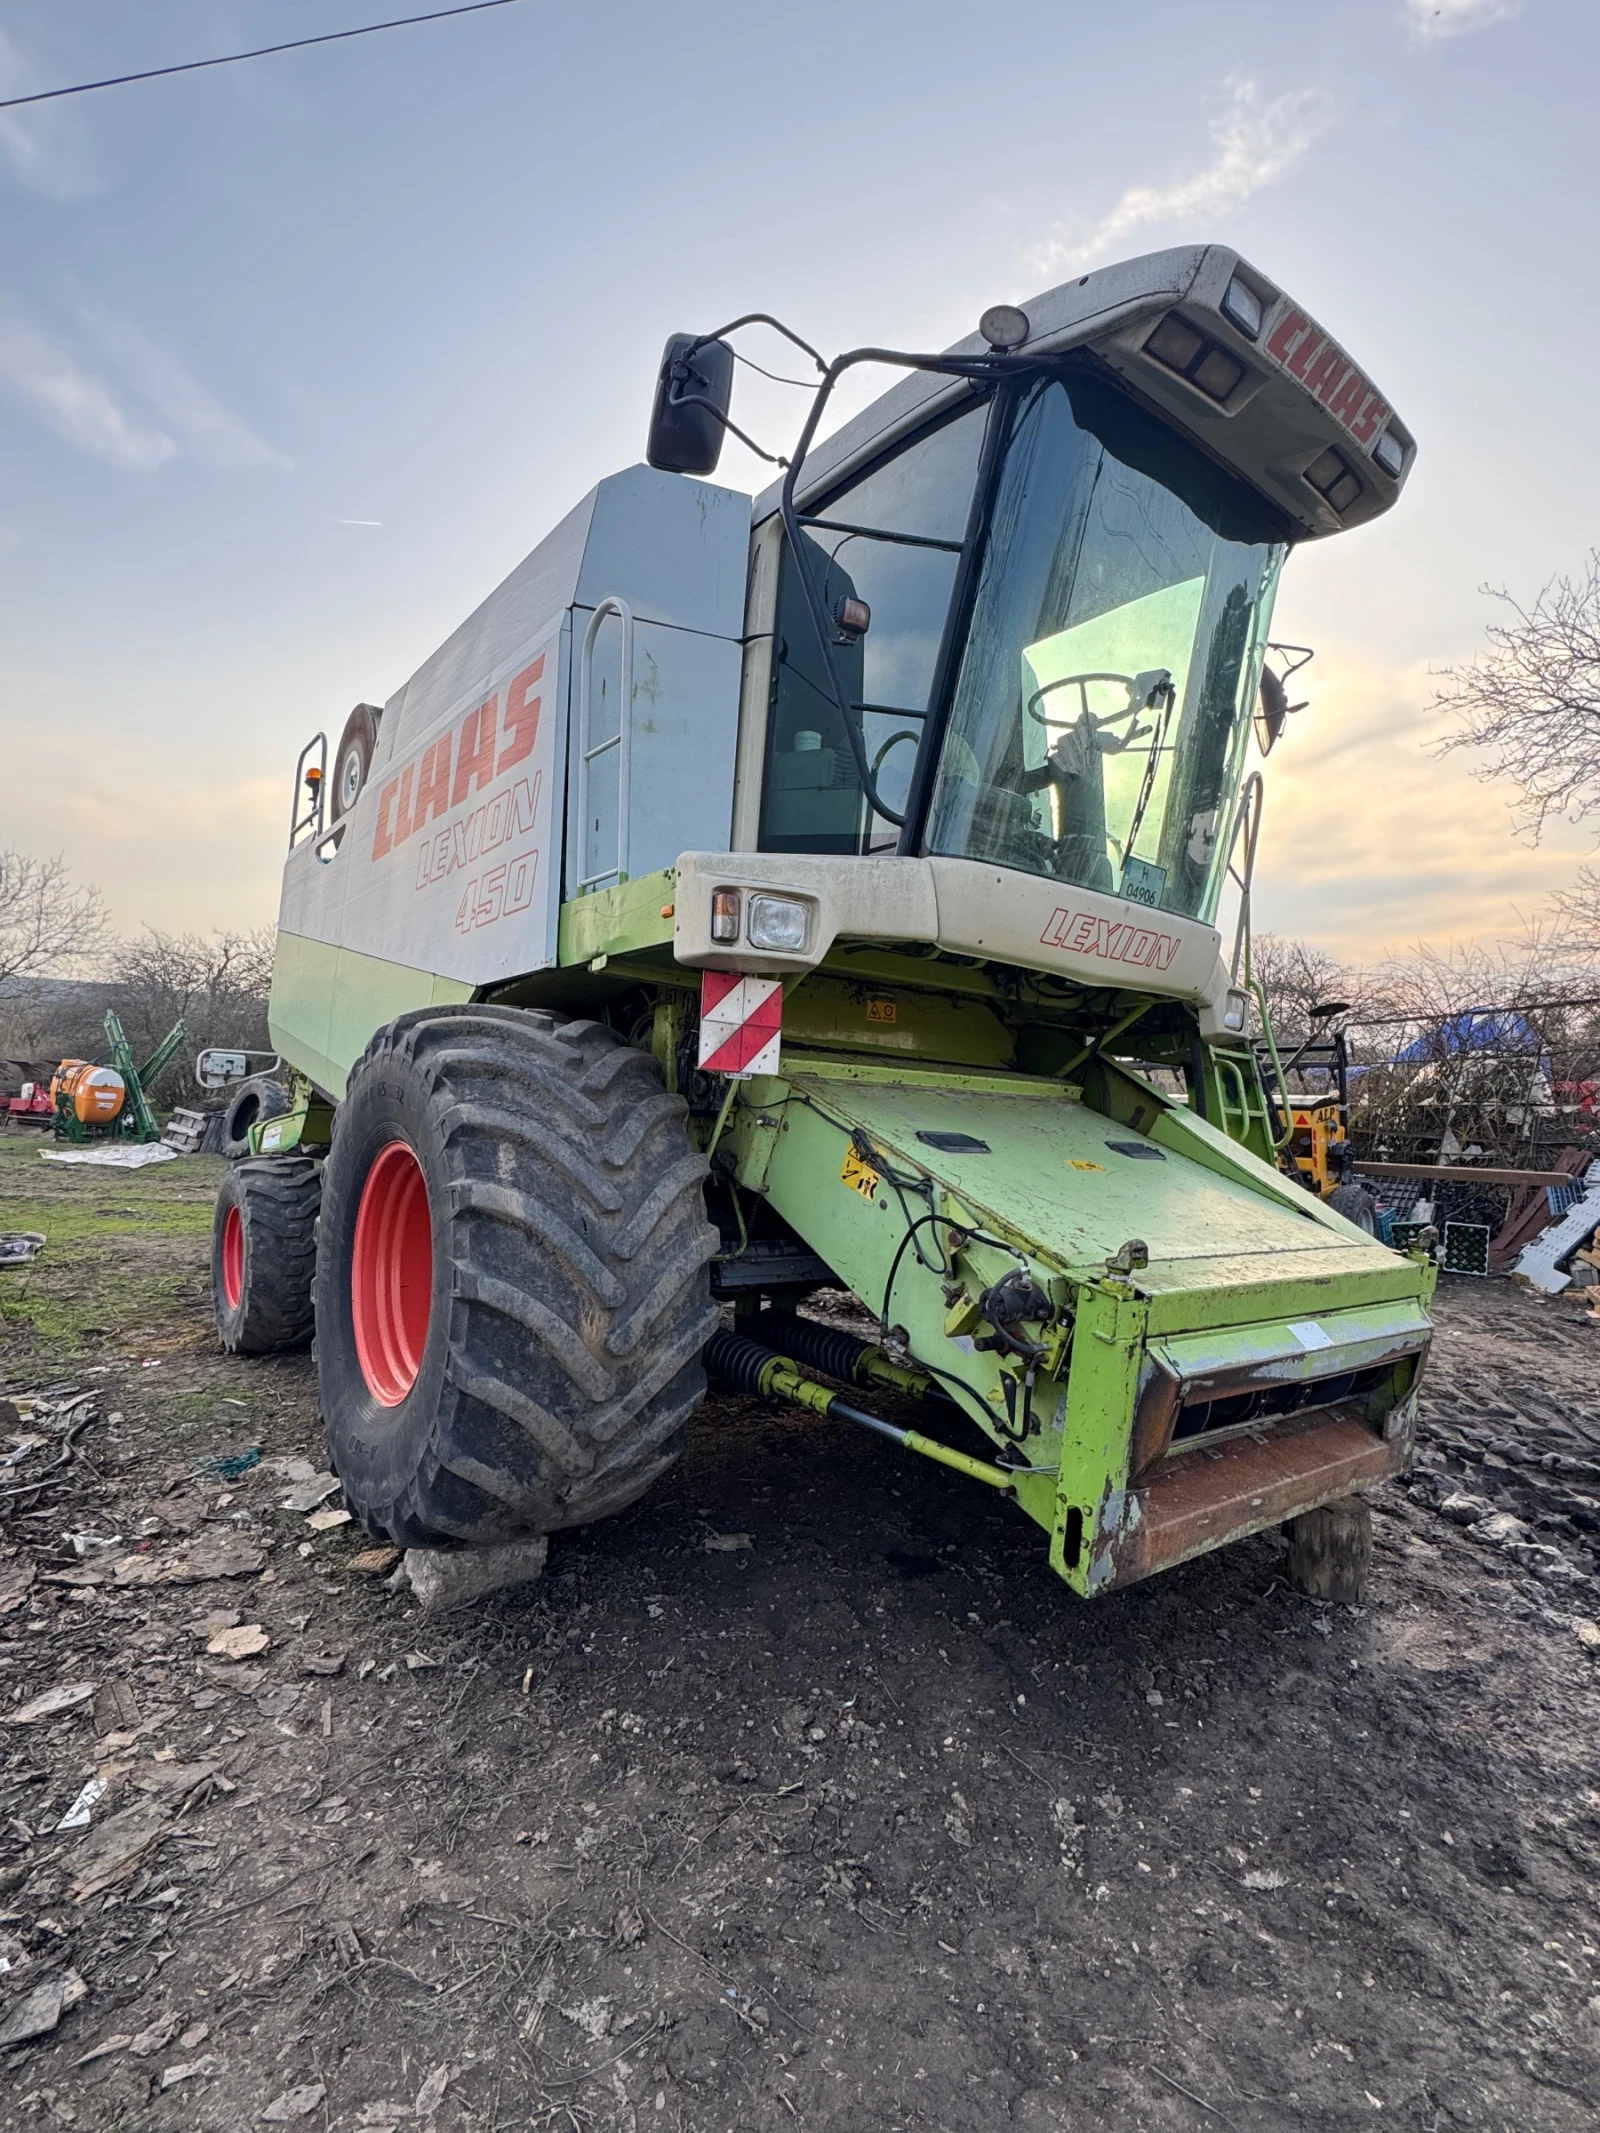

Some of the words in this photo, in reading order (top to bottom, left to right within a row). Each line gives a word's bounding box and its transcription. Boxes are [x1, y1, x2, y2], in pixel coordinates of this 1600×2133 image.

[1267, 310, 1389, 443] CLAAS
[372, 653, 545, 862] CLAAS
[416, 770, 542, 891] LEXION
[1142, 866, 1149, 881] H
[455, 849, 539, 935] 450
[1126, 883, 1156, 904] 04906
[1040, 907, 1181, 970] LEXION
